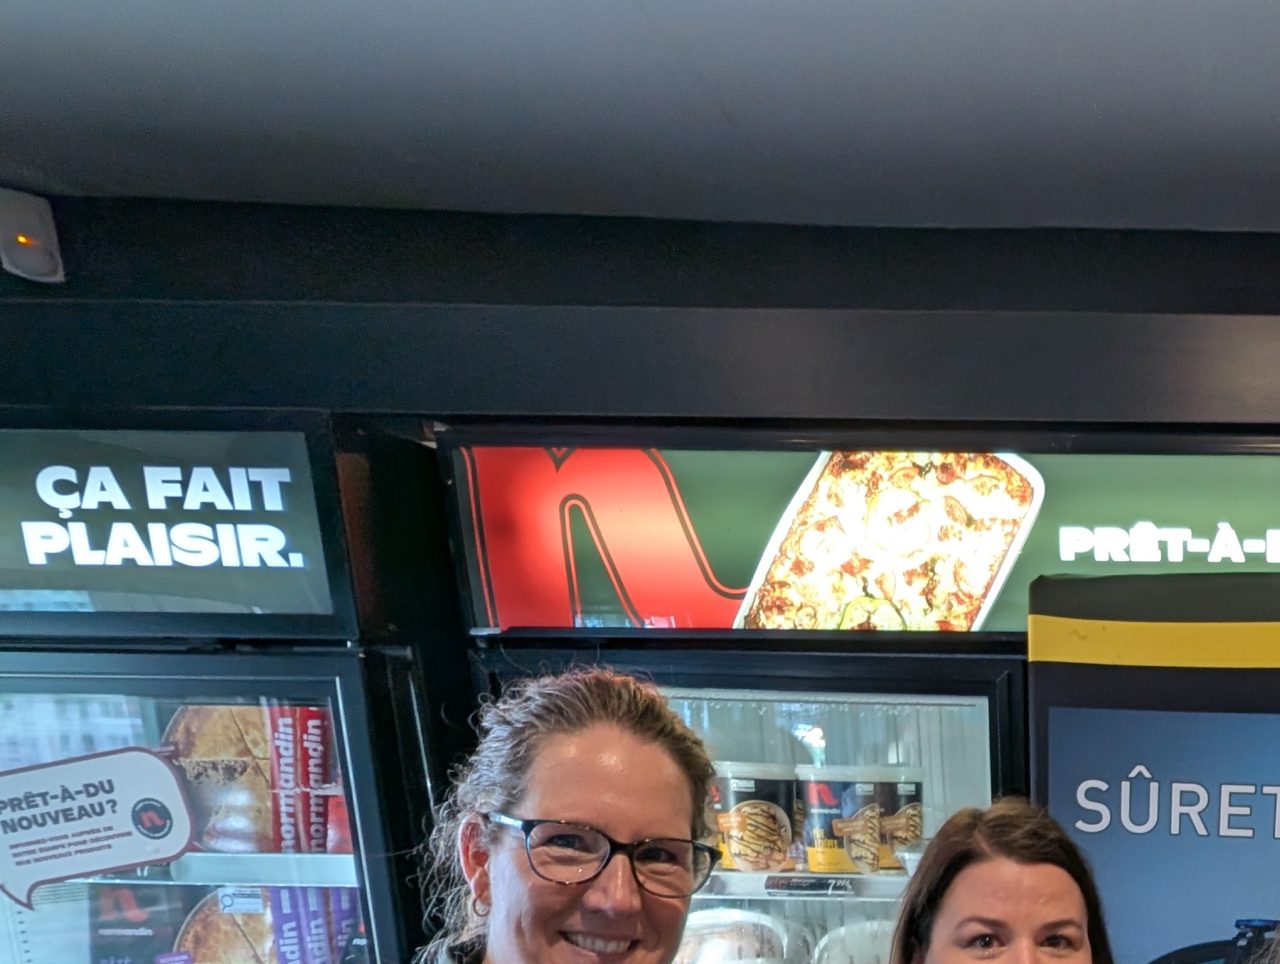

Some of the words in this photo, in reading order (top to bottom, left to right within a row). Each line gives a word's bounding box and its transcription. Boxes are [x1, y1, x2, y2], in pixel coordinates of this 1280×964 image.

[35, 465, 131, 518] ÇA
[143, 466, 291, 511] FAIT
[20, 521, 304, 568] PLAISIR.
[0, 779, 115, 815] PRÊT-À-DU
[1, 799, 118, 834] NOUVEAU?
